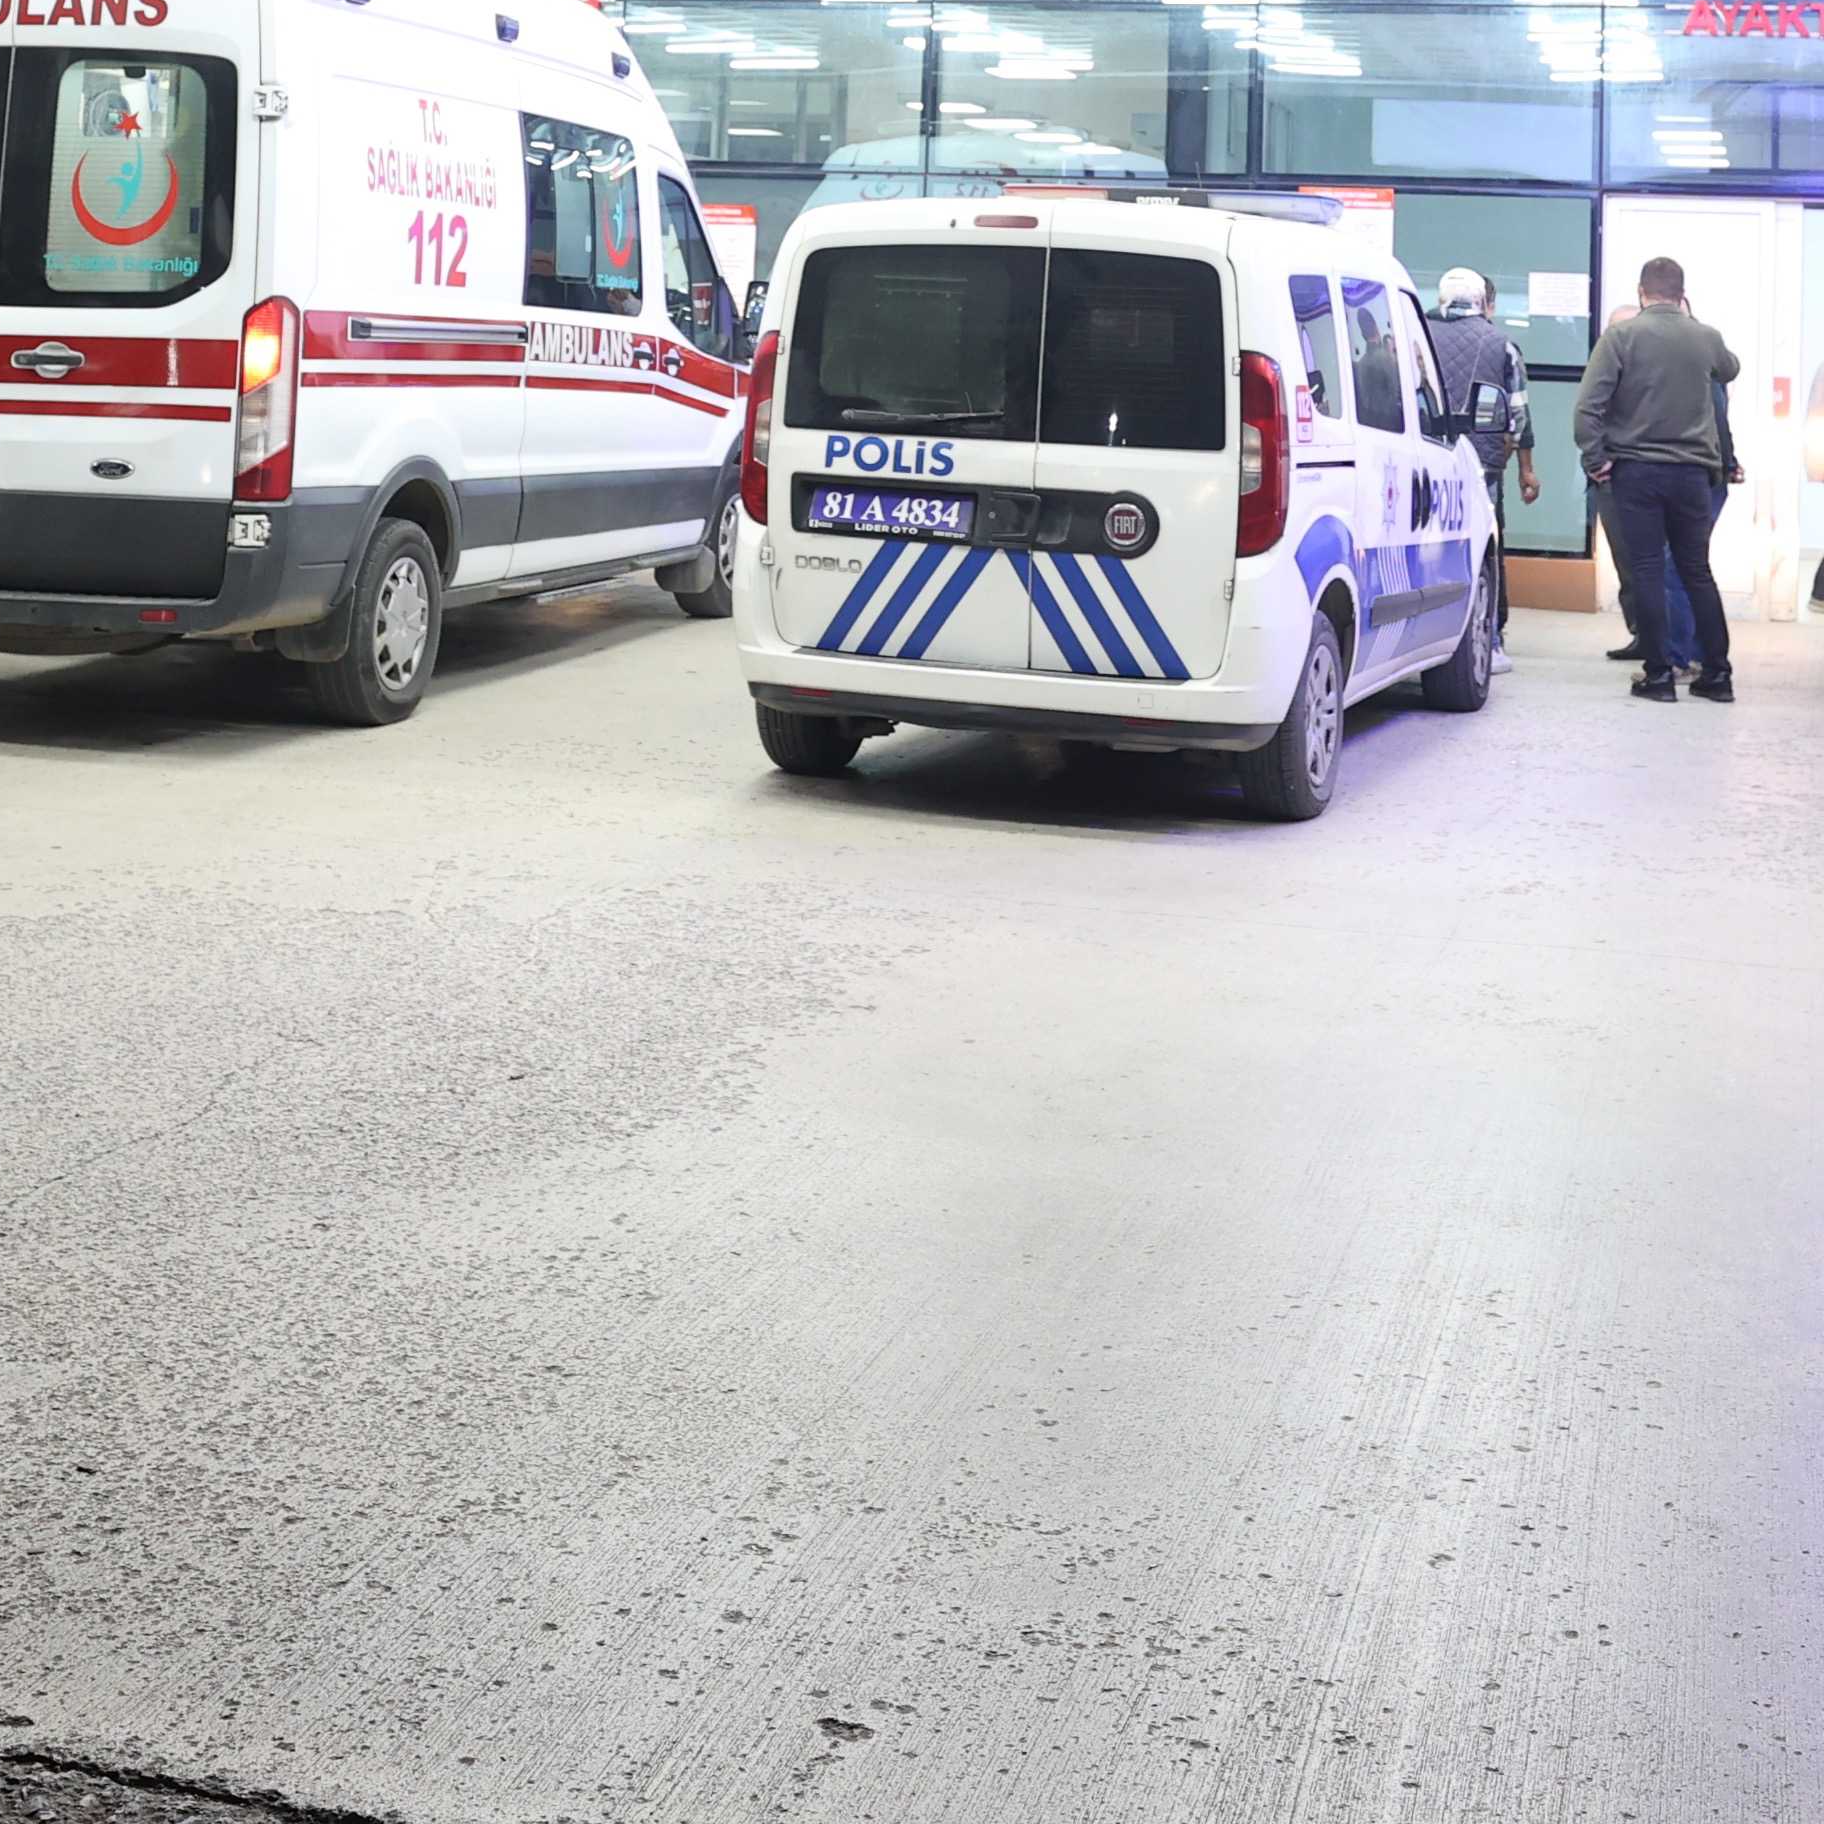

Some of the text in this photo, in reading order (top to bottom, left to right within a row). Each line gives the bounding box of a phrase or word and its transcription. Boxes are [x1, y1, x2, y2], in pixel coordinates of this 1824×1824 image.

[419, 99, 448, 145] T.C.
[367, 139, 421, 198] SAĞLIK
[408, 209, 469, 288] 112
[529, 321, 634, 368] AMBULANS
[822, 491, 961, 529] 81 A 4834
[891, 525, 919, 536] OTO
[1114, 515, 1137, 534] FIAT
[795, 554, 863, 575] DOBLO
